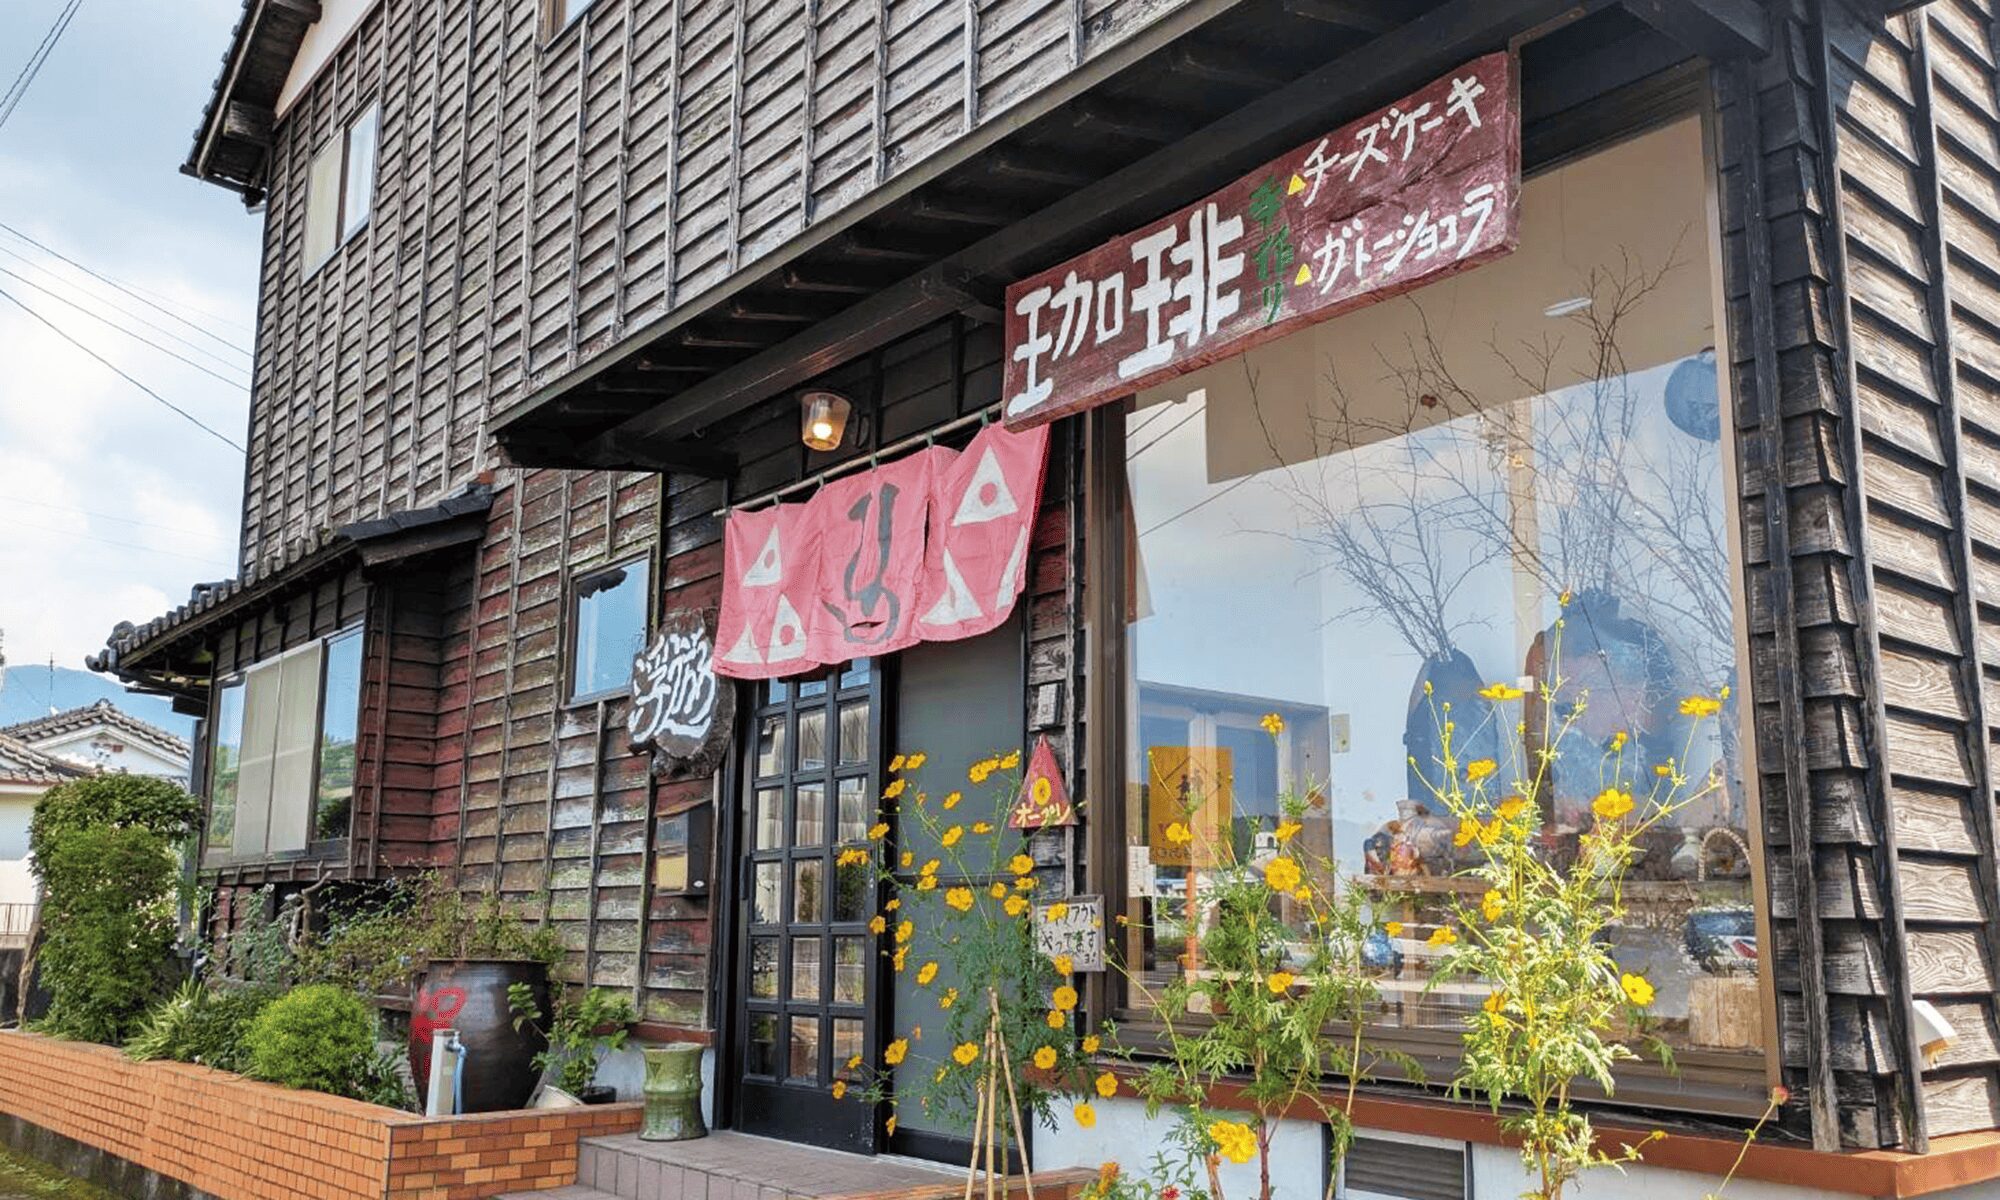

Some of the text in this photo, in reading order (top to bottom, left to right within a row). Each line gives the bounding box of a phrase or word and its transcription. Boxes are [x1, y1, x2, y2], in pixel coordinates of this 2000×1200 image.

[1302, 75, 1485, 207] チーズケーキ
[1248, 176, 1294, 324] 手作り
[1313, 183, 1504, 295] ガトーショコラ
[1008, 203, 1245, 416] 珈琲
